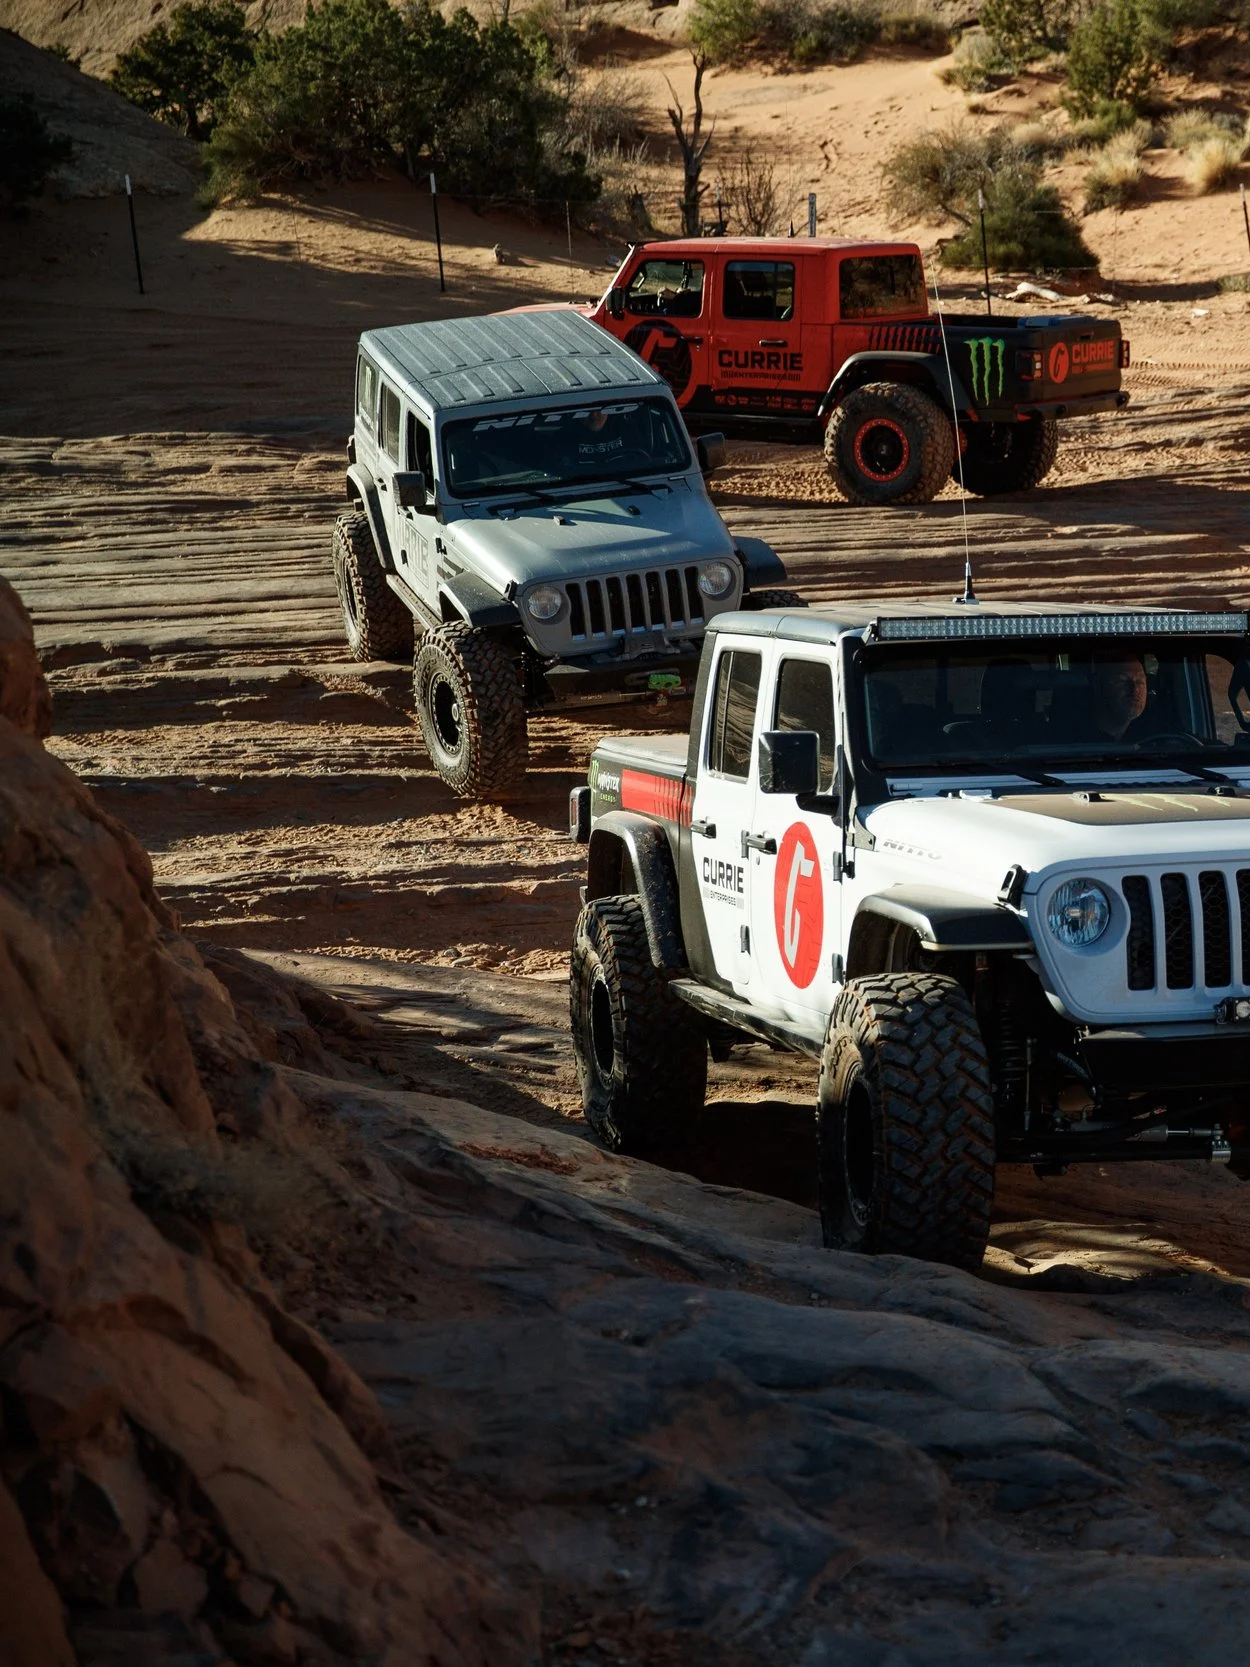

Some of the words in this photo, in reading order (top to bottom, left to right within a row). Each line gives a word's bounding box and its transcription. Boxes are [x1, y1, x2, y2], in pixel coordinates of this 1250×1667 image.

[718, 350, 803, 371] CURRIE
[1072, 340, 1115, 363] CURRIE
[472, 403, 639, 431] NITTO
[703, 857, 744, 893] CURRIE
